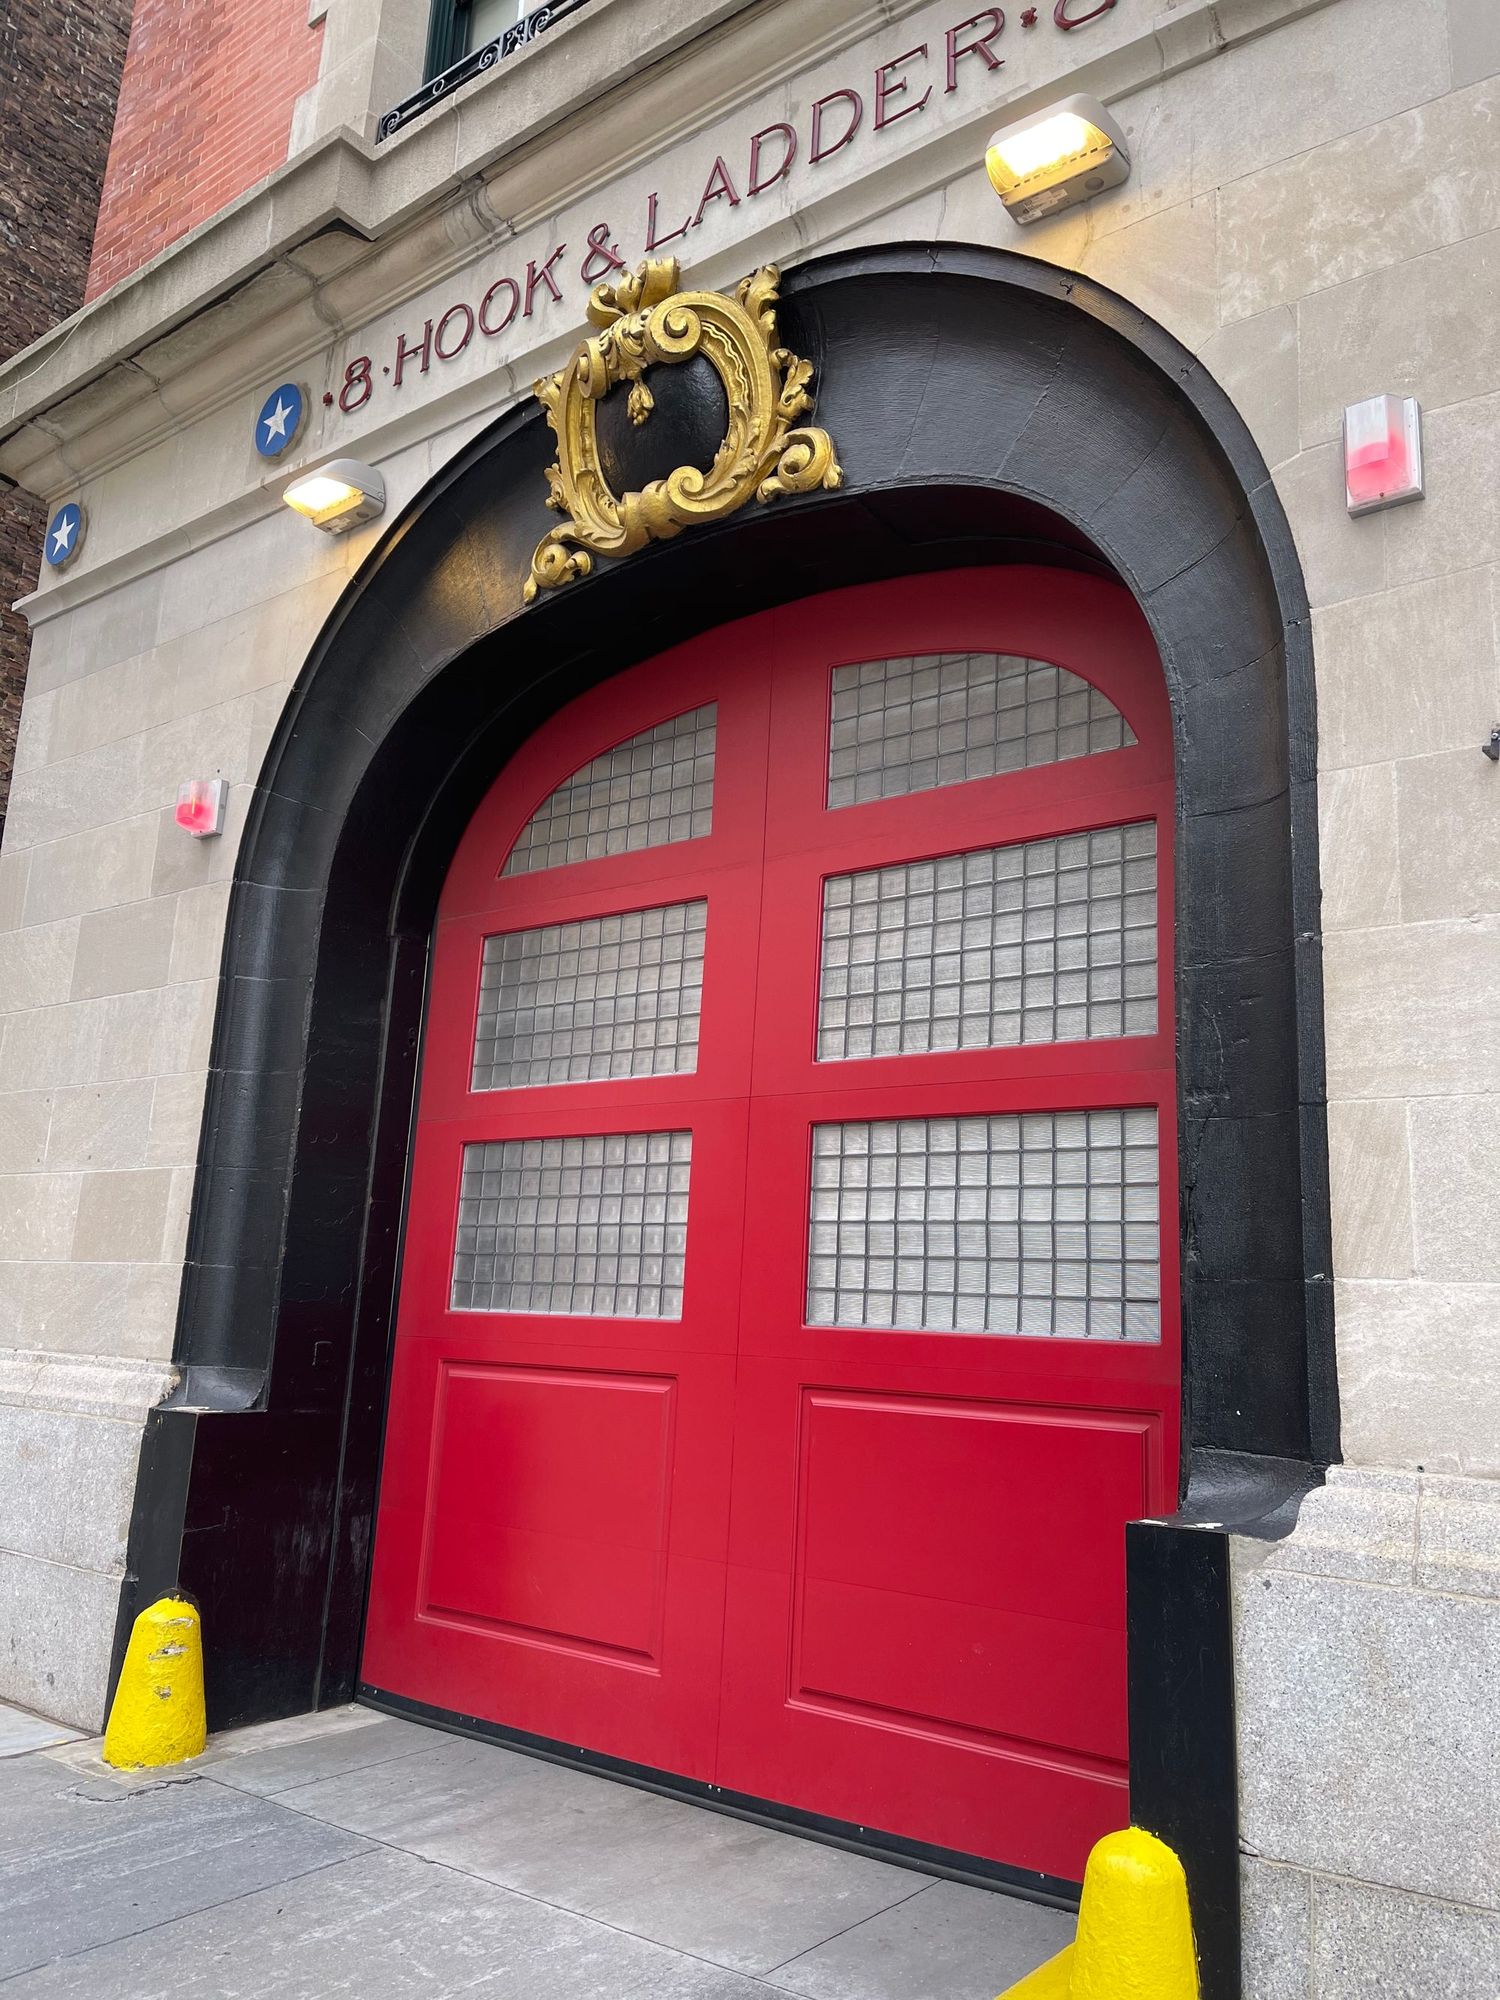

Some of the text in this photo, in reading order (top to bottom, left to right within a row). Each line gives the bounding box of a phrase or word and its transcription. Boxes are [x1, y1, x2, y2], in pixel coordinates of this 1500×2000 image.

[392, 243, 568, 387] HOOK
[580, 222, 626, 285] &
[643, 5, 1006, 253] LADDER
